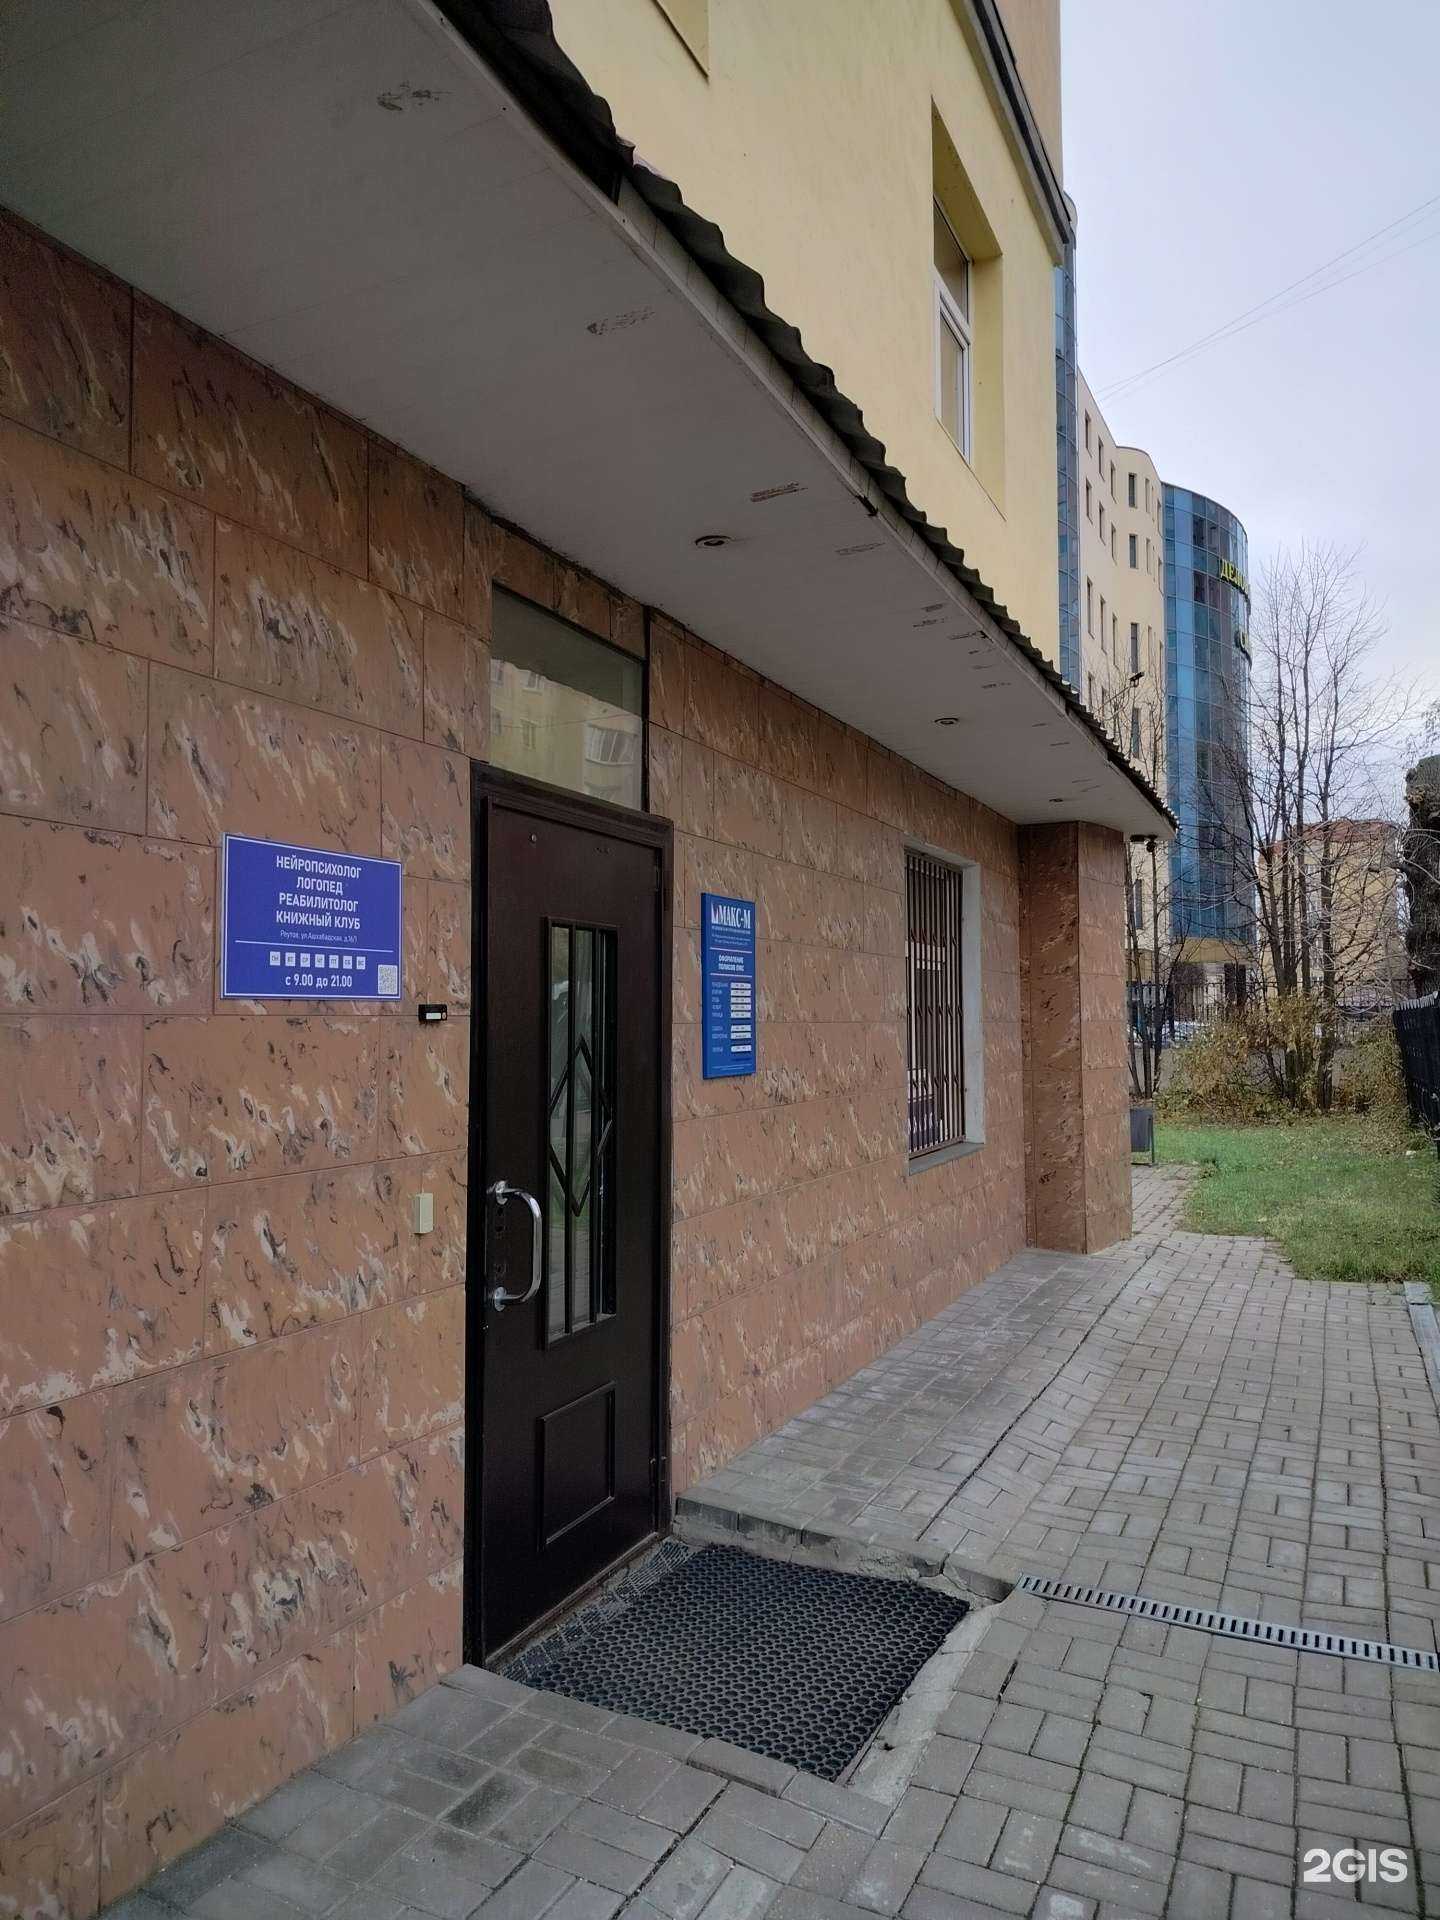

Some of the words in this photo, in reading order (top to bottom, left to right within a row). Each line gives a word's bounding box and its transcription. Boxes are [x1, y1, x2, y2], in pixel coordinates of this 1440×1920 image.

[276, 854, 362, 879] НЕЙРОПСИХОЛОГ
[296, 876, 344, 896] ЛОГОПЕД
[279, 892, 359, 913] РЕАБИЛИТОЛОГ
[275, 910, 332, 927] КНИЖНЫЙ
[334, 916, 361, 930] КЛУБ
[294, 973, 314, 987] 9.00
[316, 977, 329, 988] до
[330, 975, 353, 988] 21.00
